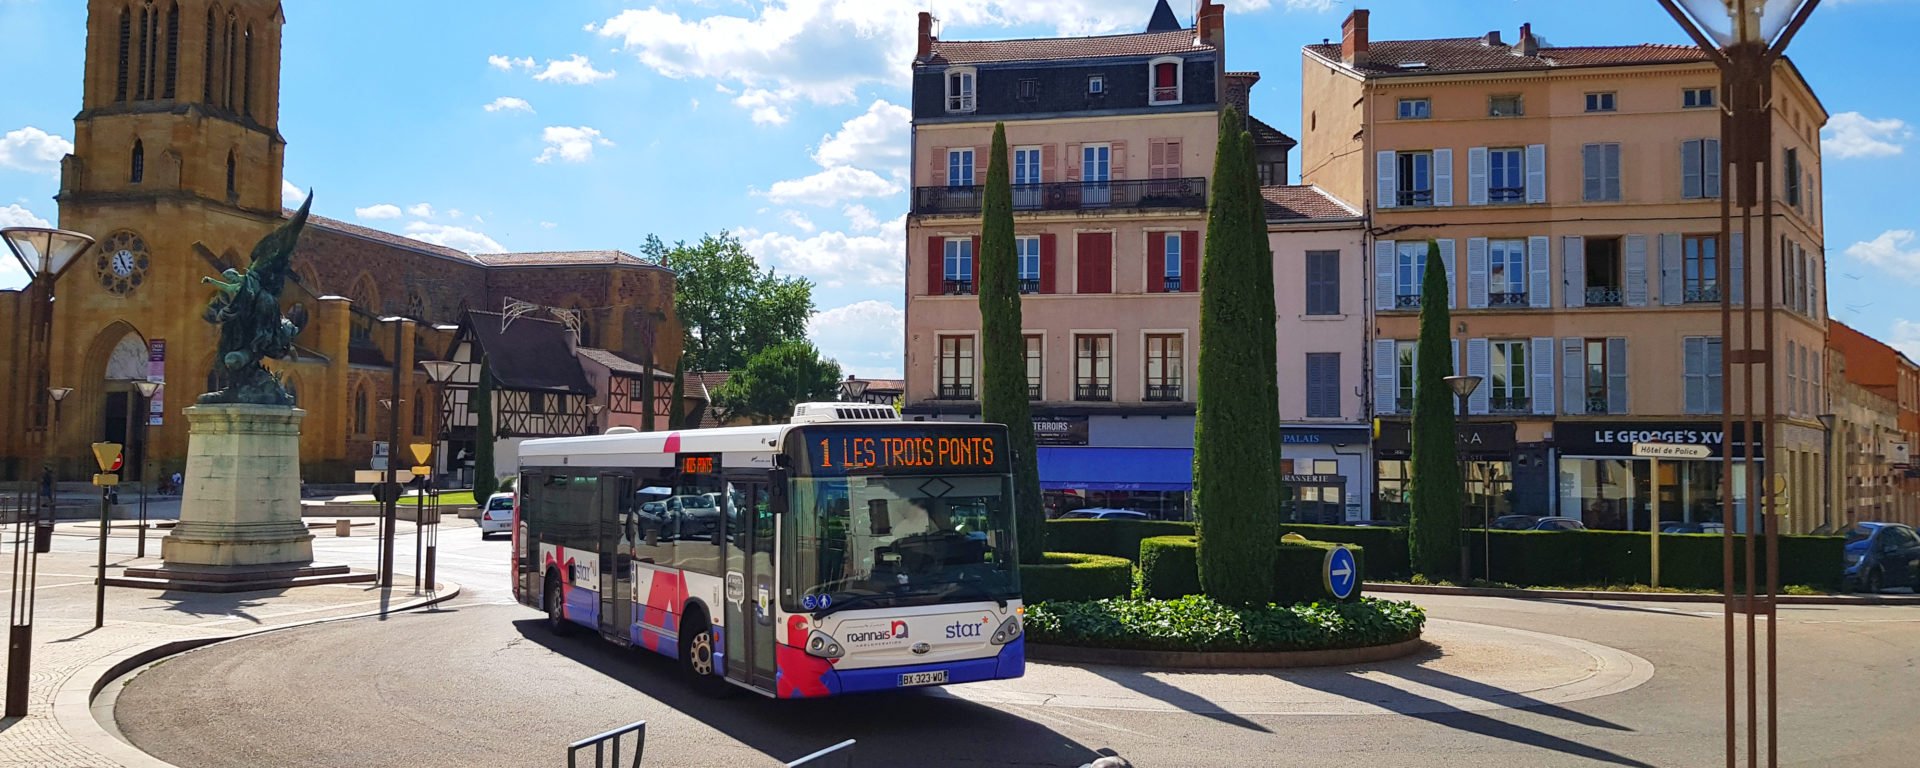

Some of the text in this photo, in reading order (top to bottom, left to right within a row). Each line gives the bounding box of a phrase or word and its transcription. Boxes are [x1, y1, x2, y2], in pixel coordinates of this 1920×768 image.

[1032, 421, 1068, 431] TERROIRS
[1283, 434, 1320, 443] PALAIS
[1595, 430, 1614, 443] LE
[820, 437, 995, 467] 1 LES TROIS PONTS
[1640, 445, 1698, 456] Hôtel de Police
[847, 630, 891, 643] roannais
